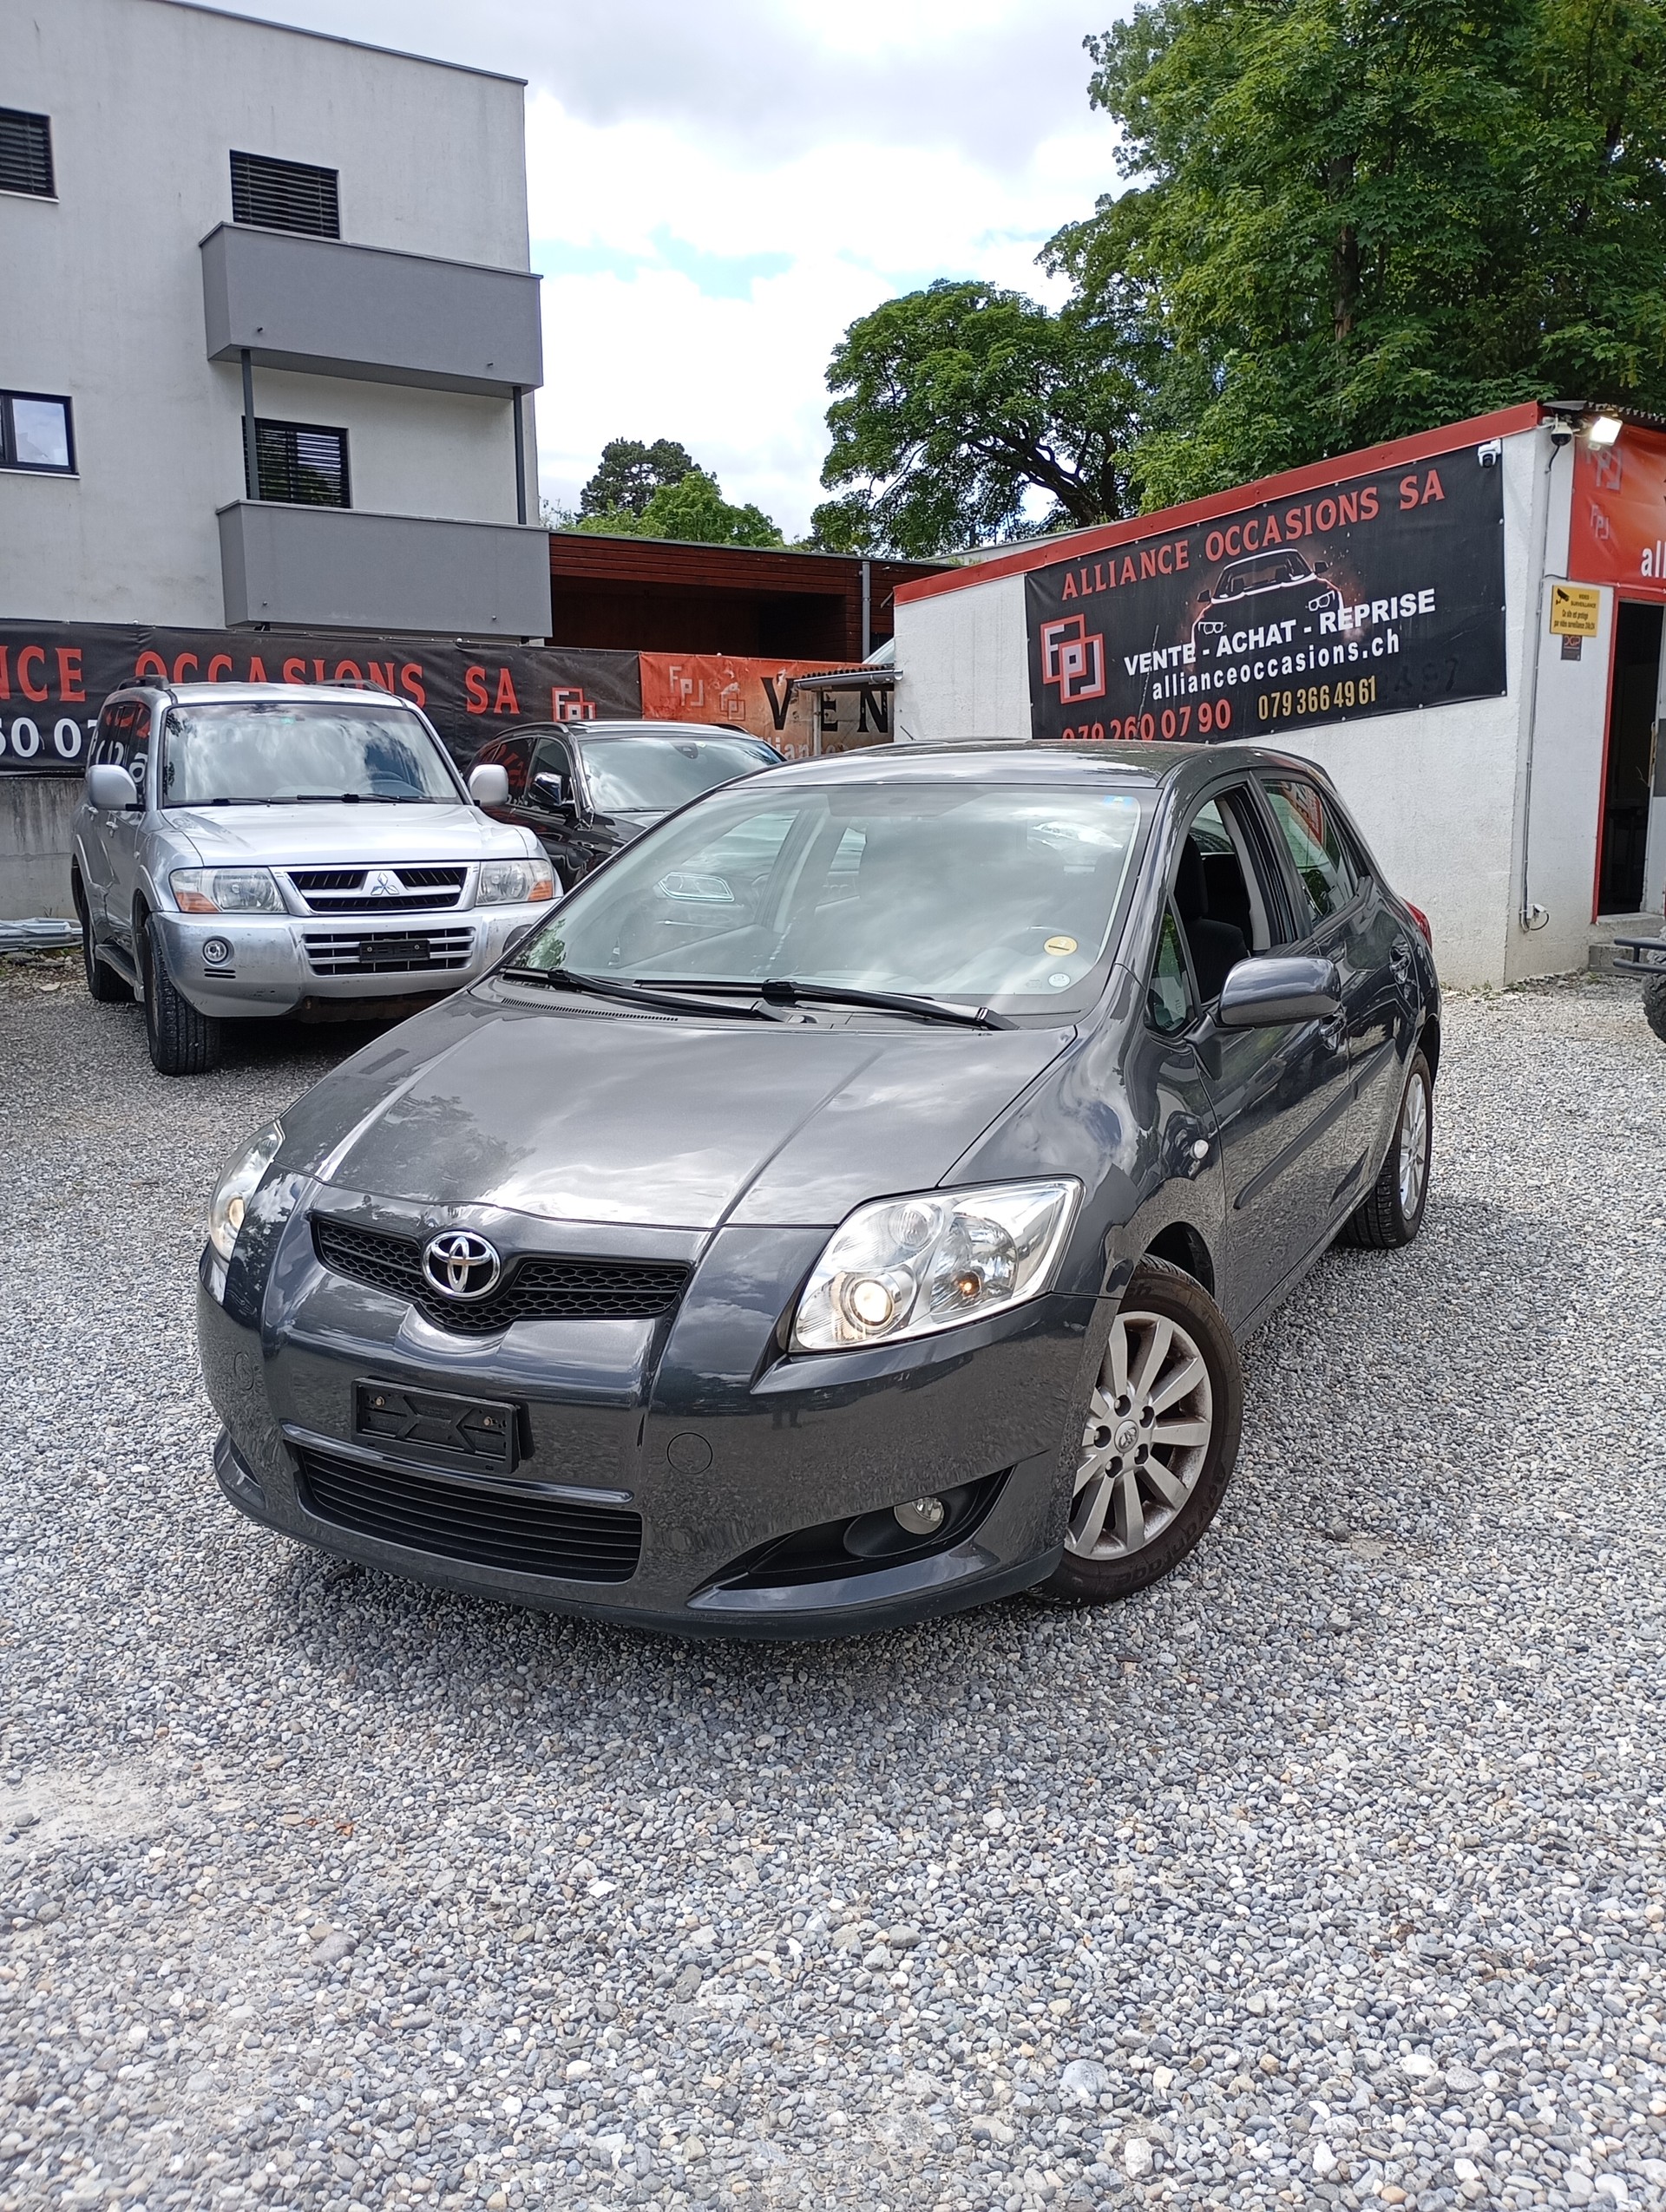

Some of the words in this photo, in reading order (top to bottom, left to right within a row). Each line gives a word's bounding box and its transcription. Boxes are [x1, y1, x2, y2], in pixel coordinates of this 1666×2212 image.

[1061, 540, 1190, 601] ALLIANCE
[1205, 487, 1380, 562] OCCASIONS
[1399, 468, 1446, 511] SA
[1124, 643, 1197, 677] VENTE
[1216, 619, 1296, 658] ACHAT
[1319, 588, 1436, 634] REPRISE
[1152, 628, 1400, 700] allianceoccasions.ch
[465, 665, 520, 715] SA
[1296, 684, 1331, 714] 366
[1334, 680, 1354, 708] 49
[1359, 676, 1377, 704] 61
[0, 717, 40, 759] 0
[1161, 706, 1191, 739] 07
[1198, 699, 1231, 733] 90
